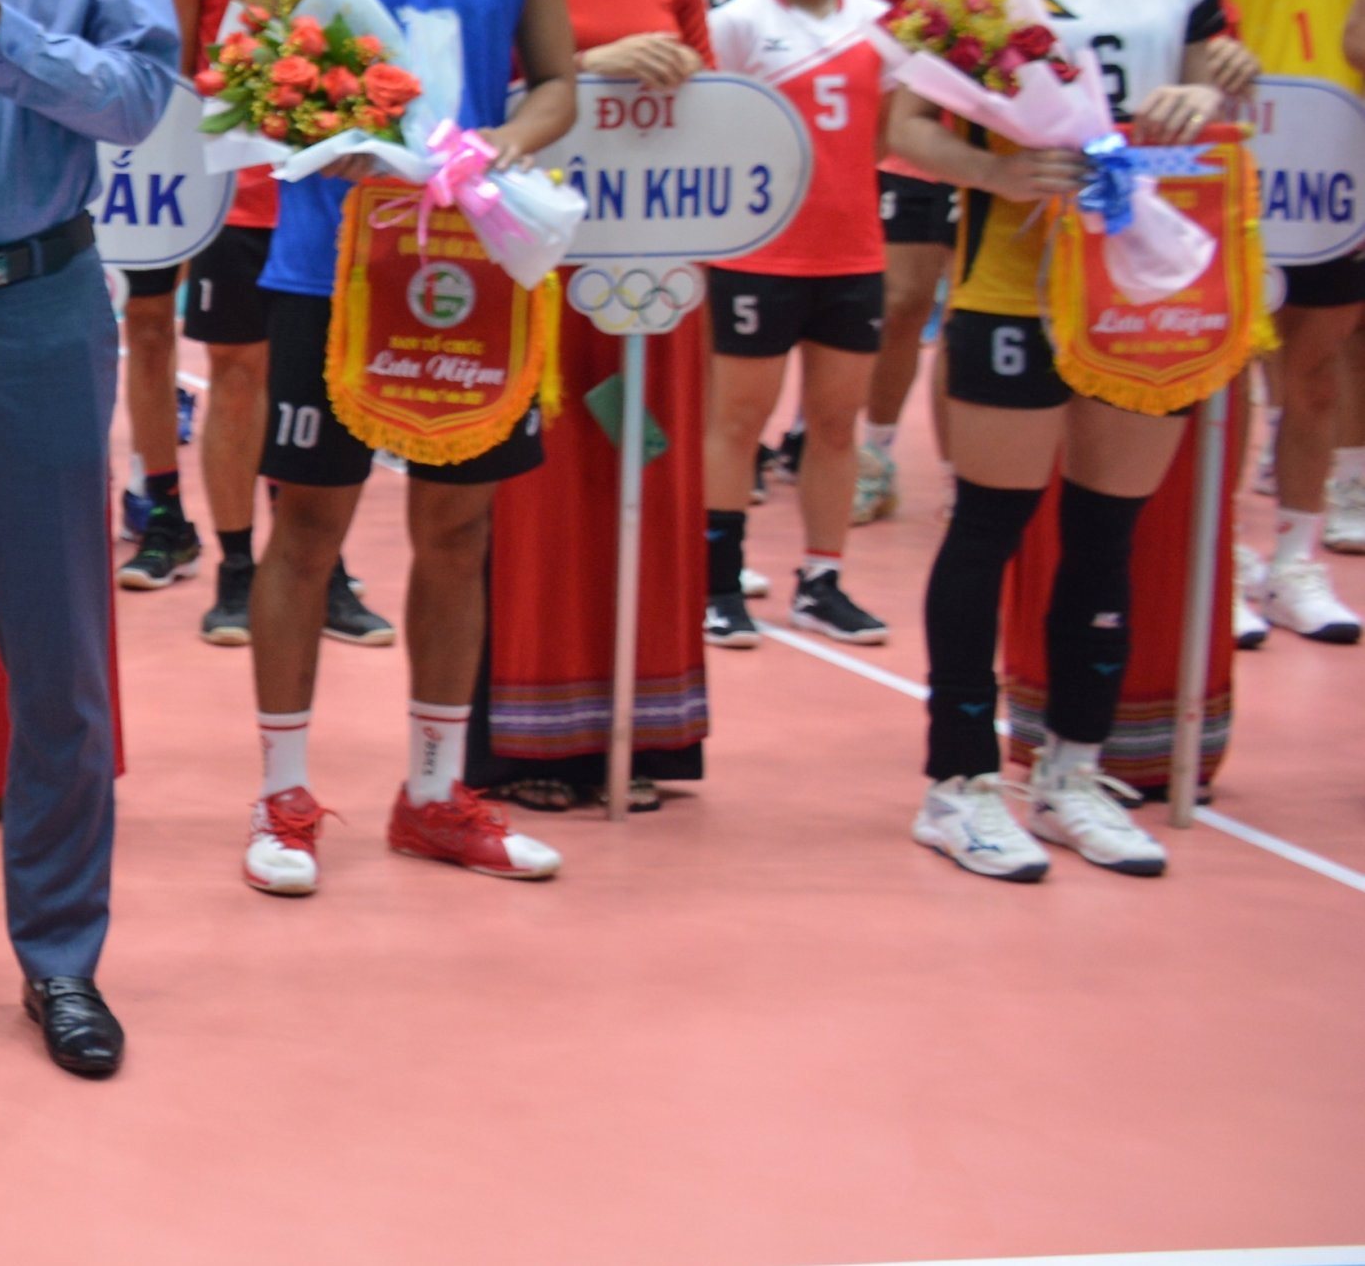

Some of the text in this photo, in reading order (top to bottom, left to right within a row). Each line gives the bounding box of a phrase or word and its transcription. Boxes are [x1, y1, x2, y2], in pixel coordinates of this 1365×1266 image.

[1291, 9, 1316, 63] 1
[594, 83, 676, 137] ĐỘI
[814, 74, 849, 131] 5
[644, 164, 731, 221] KHU
[748, 164, 772, 215] 3
[1257, 168, 1356, 223] ANG
[733, 296, 760, 334] 5
[990, 327, 1026, 376] 6
[277, 400, 320, 448] 10
